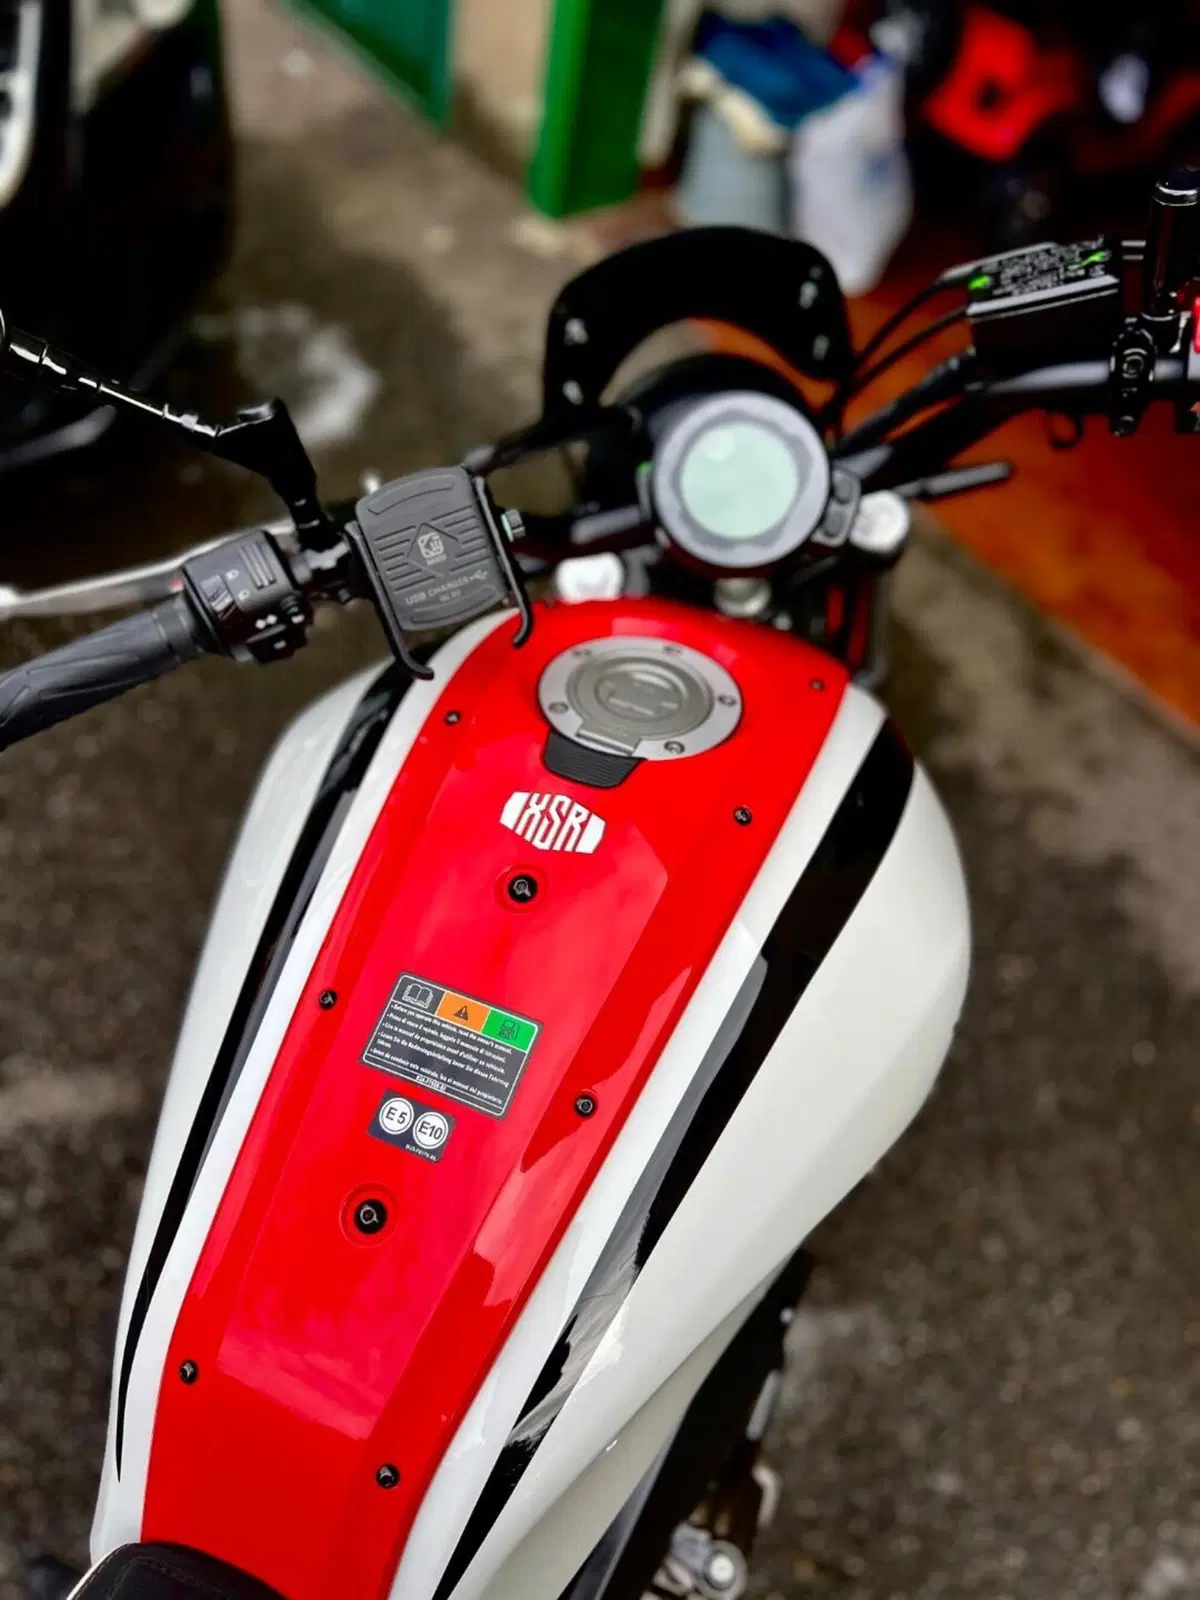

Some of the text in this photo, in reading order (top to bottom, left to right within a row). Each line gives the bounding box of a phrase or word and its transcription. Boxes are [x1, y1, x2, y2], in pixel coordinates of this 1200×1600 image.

[405, 591, 426, 605] USB
[515, 792, 591, 852] XSR
[418, 1120, 443, 1140] E10
